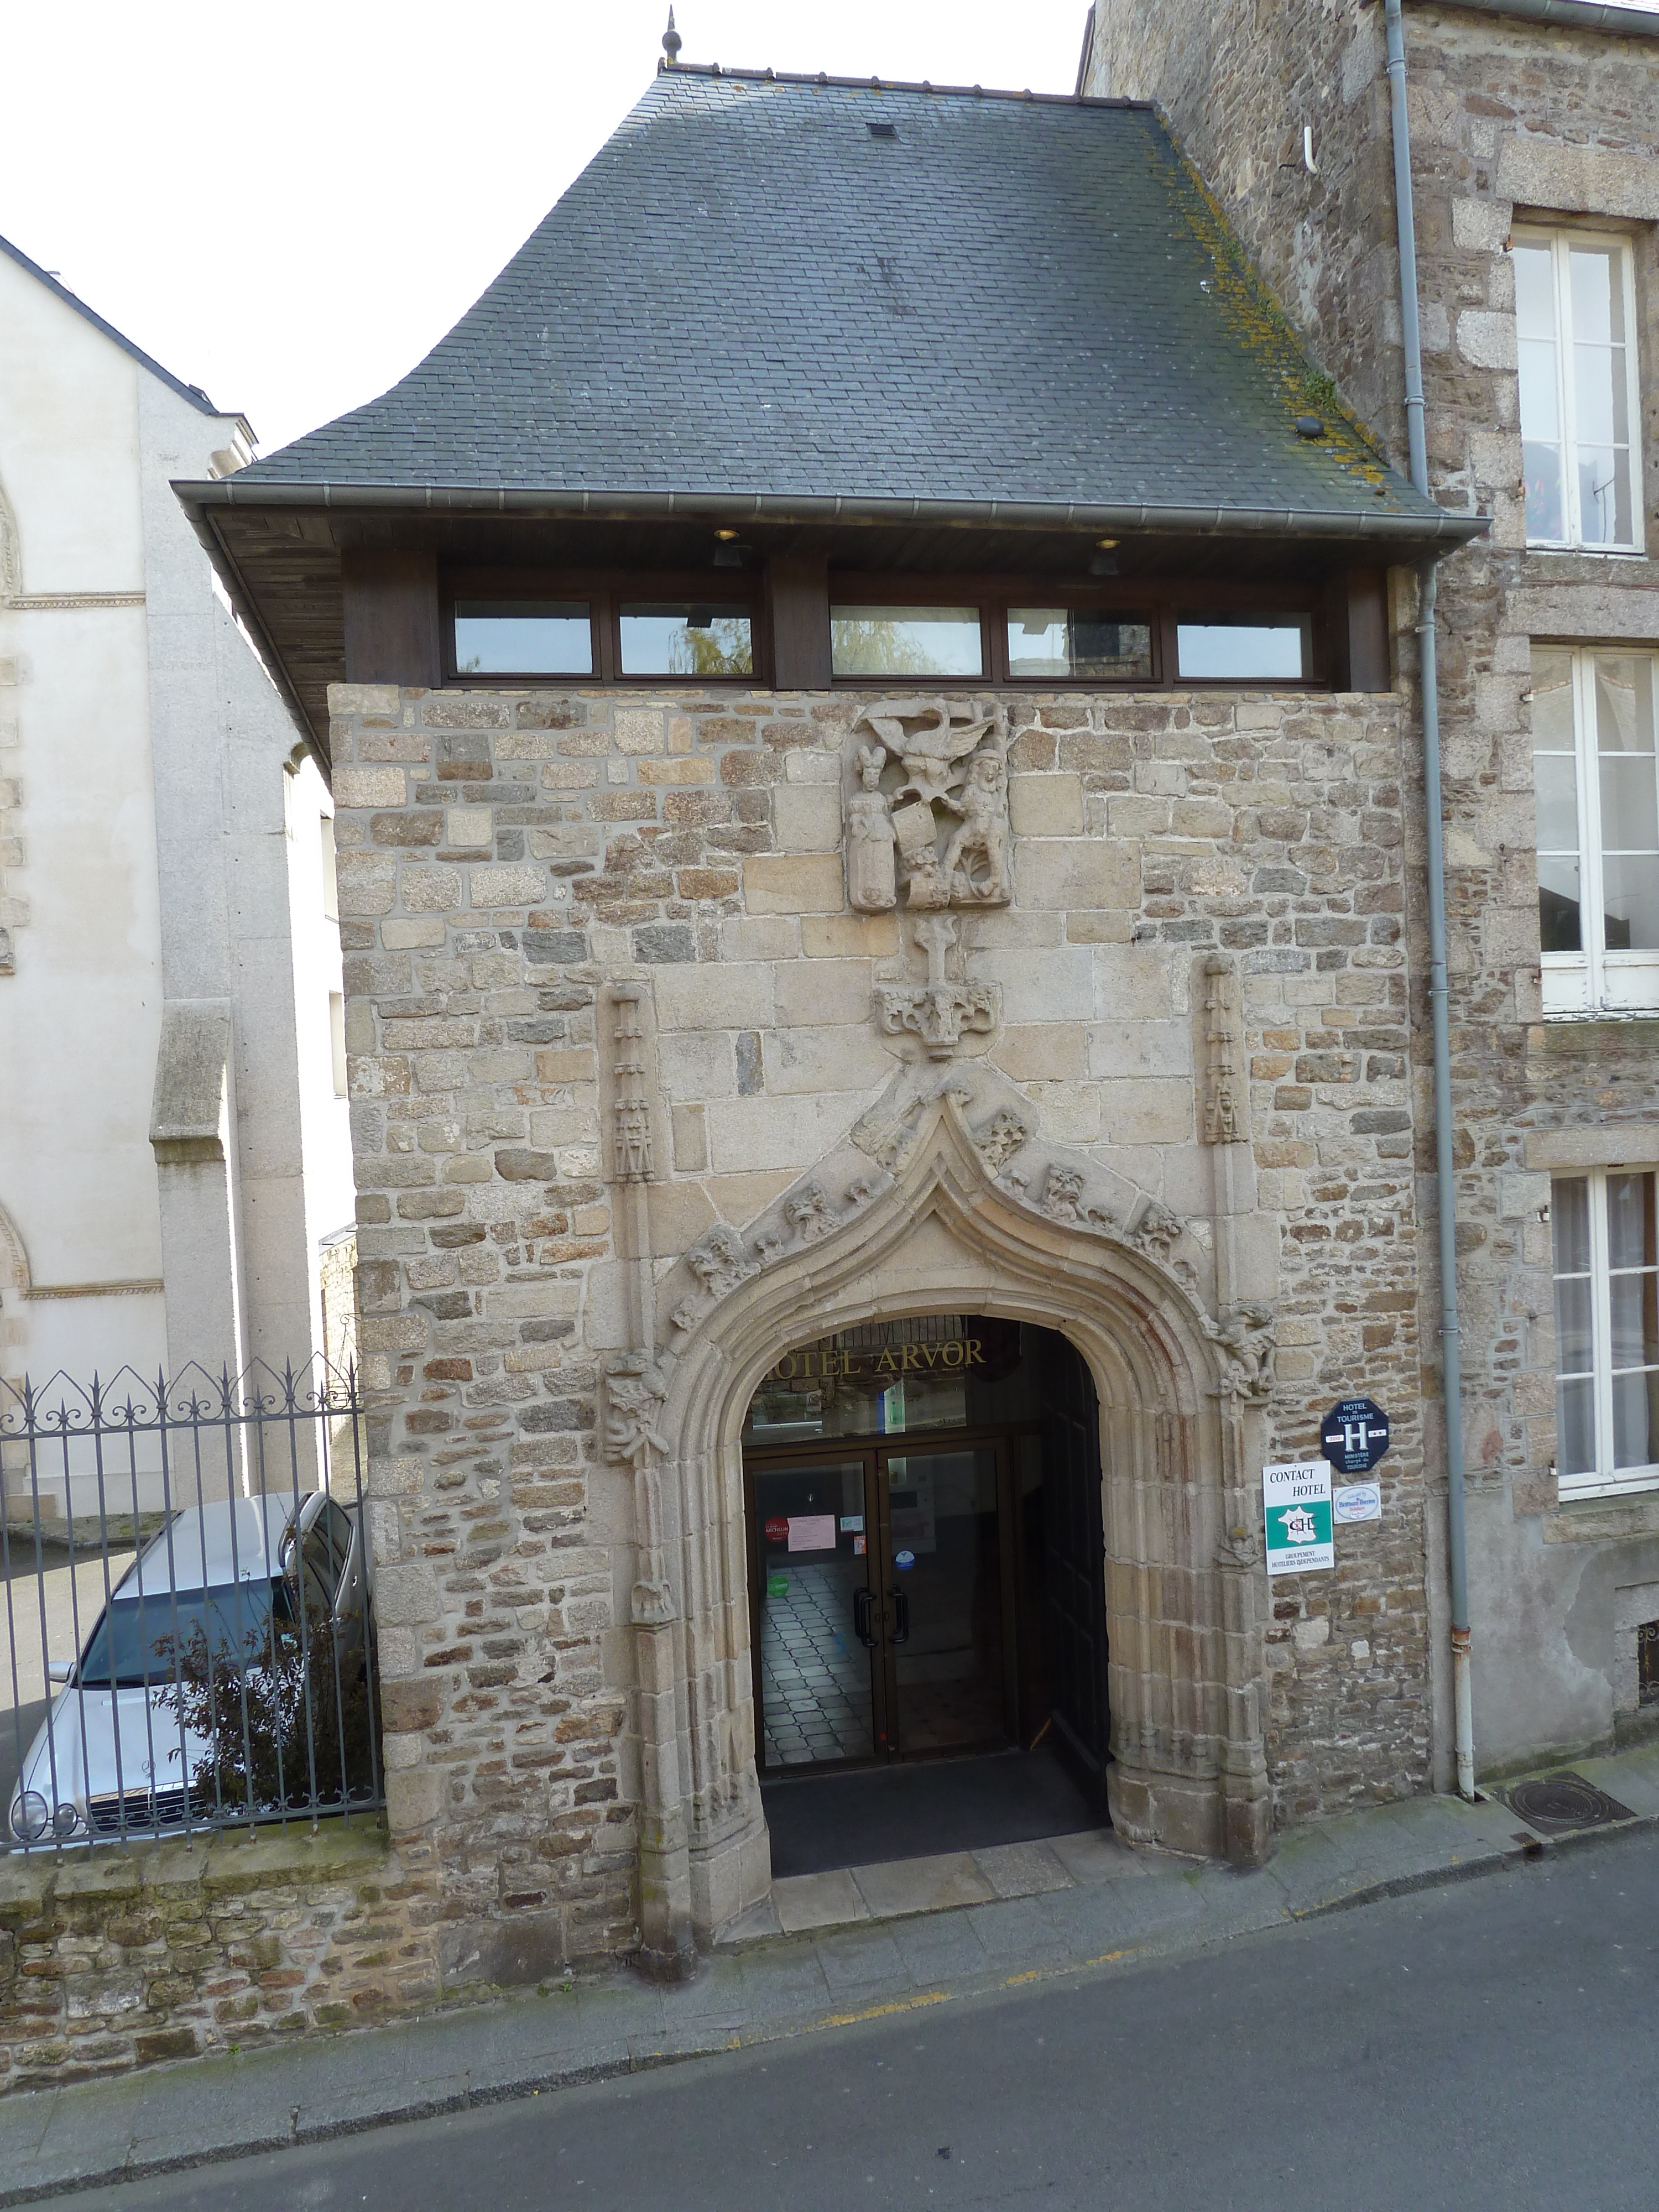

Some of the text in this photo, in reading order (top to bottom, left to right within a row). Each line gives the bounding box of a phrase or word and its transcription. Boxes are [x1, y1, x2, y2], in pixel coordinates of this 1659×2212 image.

[874, 1339, 987, 1372] ARVOR
[1343, 1403, 1368, 1411] HOTEL
[1337, 1413, 1374, 1422] TOURISME
[1344, 1422, 1369, 1452] H
[1270, 1469, 1315, 1483] CONTACT
[1293, 1484, 1326, 1496] HOTEL
[1285, 1551, 1315, 1559] GROUPEMENT
